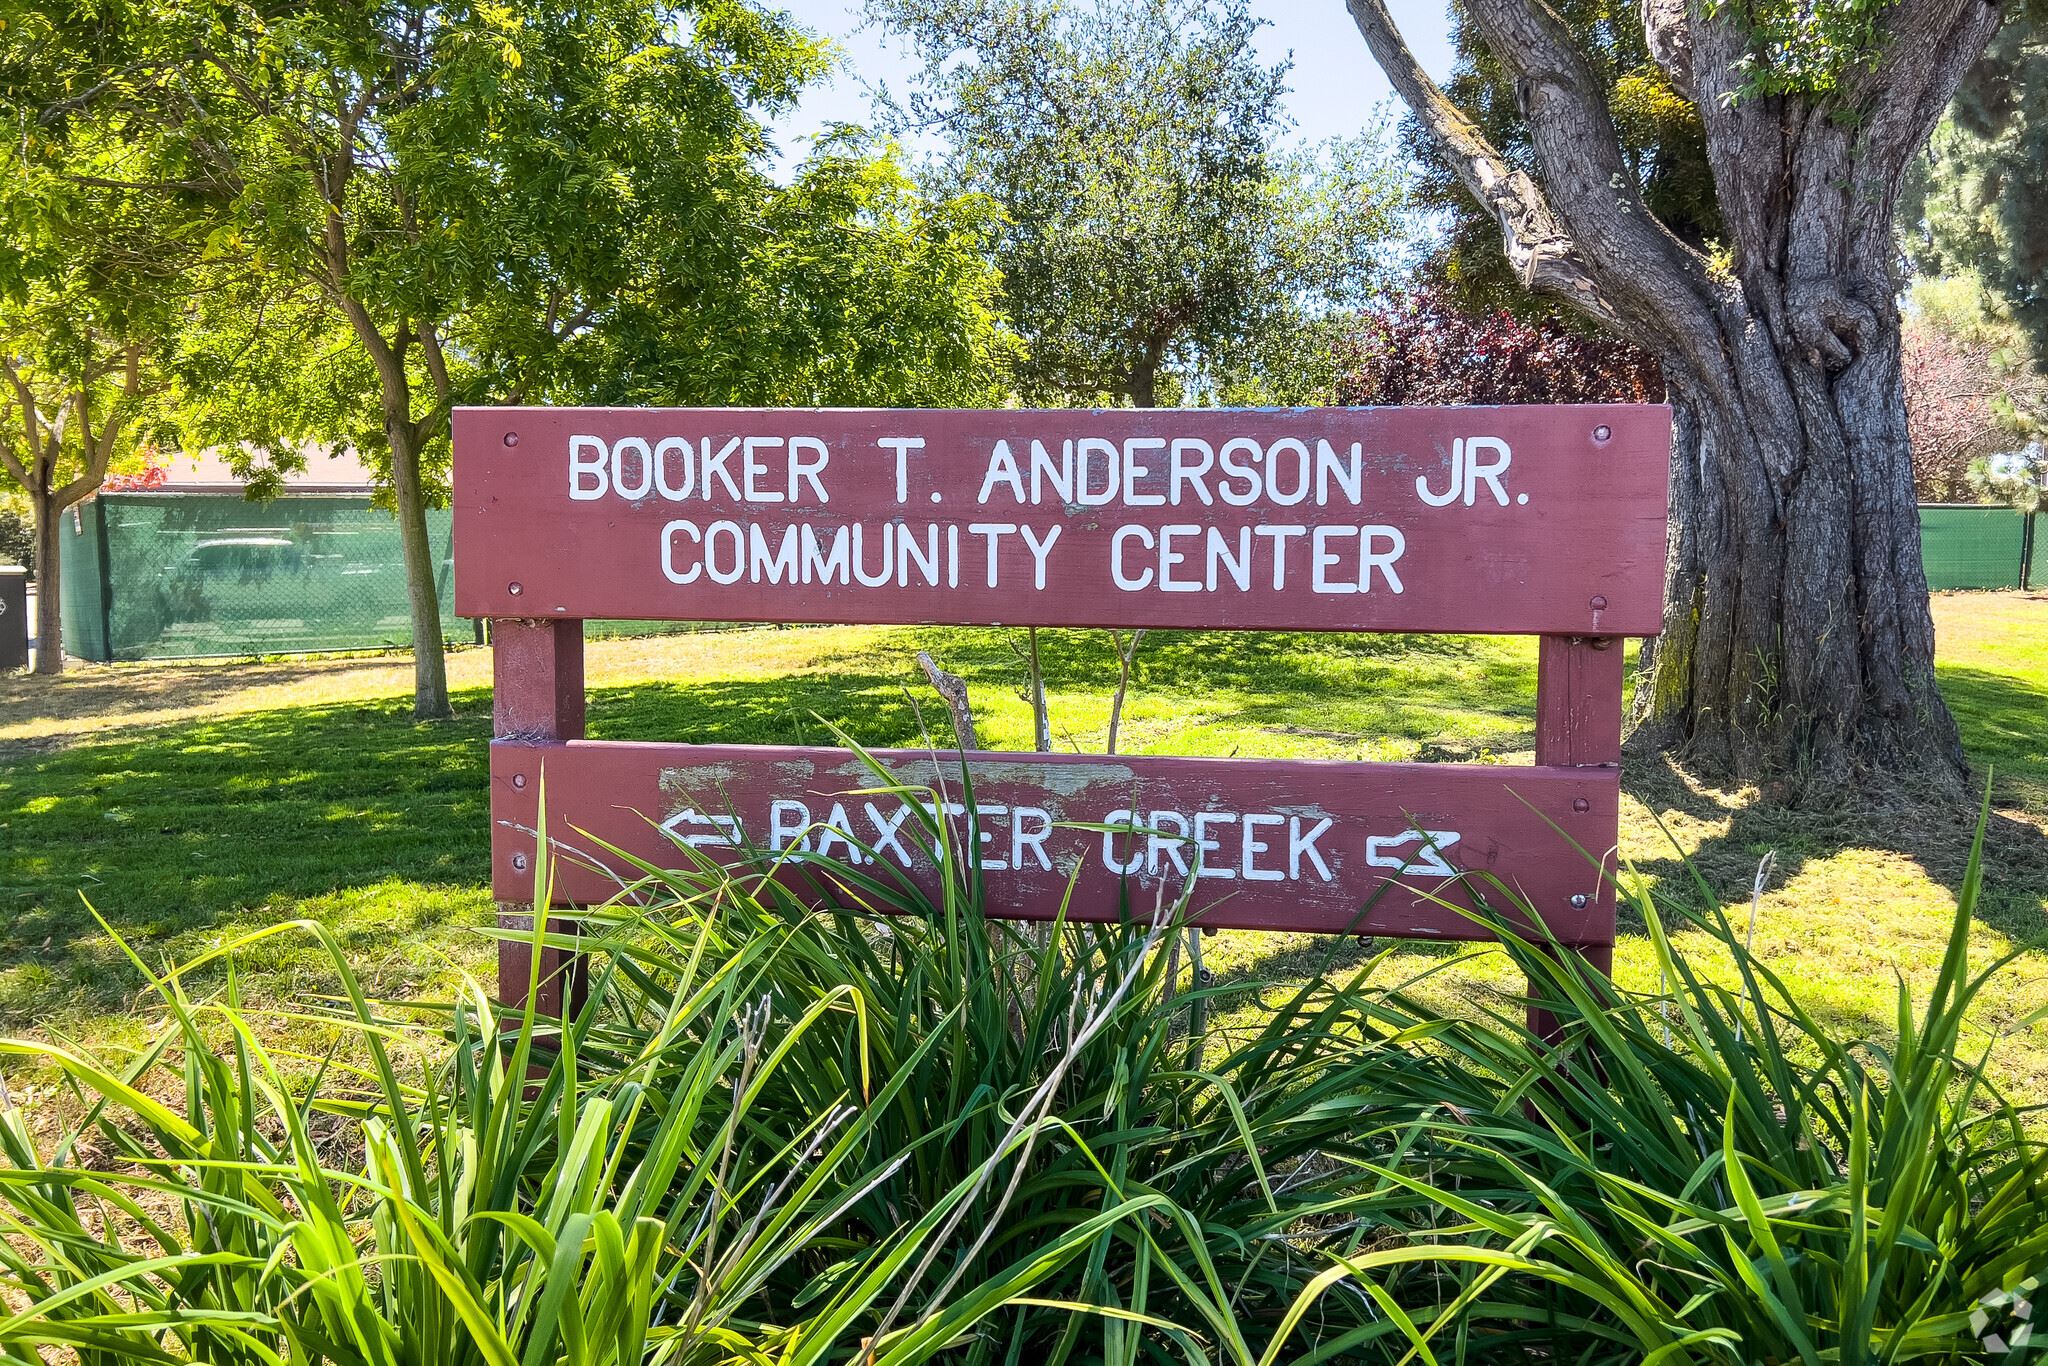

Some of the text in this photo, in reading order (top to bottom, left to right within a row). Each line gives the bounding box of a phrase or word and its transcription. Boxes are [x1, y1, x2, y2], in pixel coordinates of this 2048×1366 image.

[568, 434, 1530, 507] BOOKER T. ANDERSON JR.
[660, 519, 1406, 594] COMMUNITY CENTER
[769, 799, 1334, 882] BAXTER CREEK
